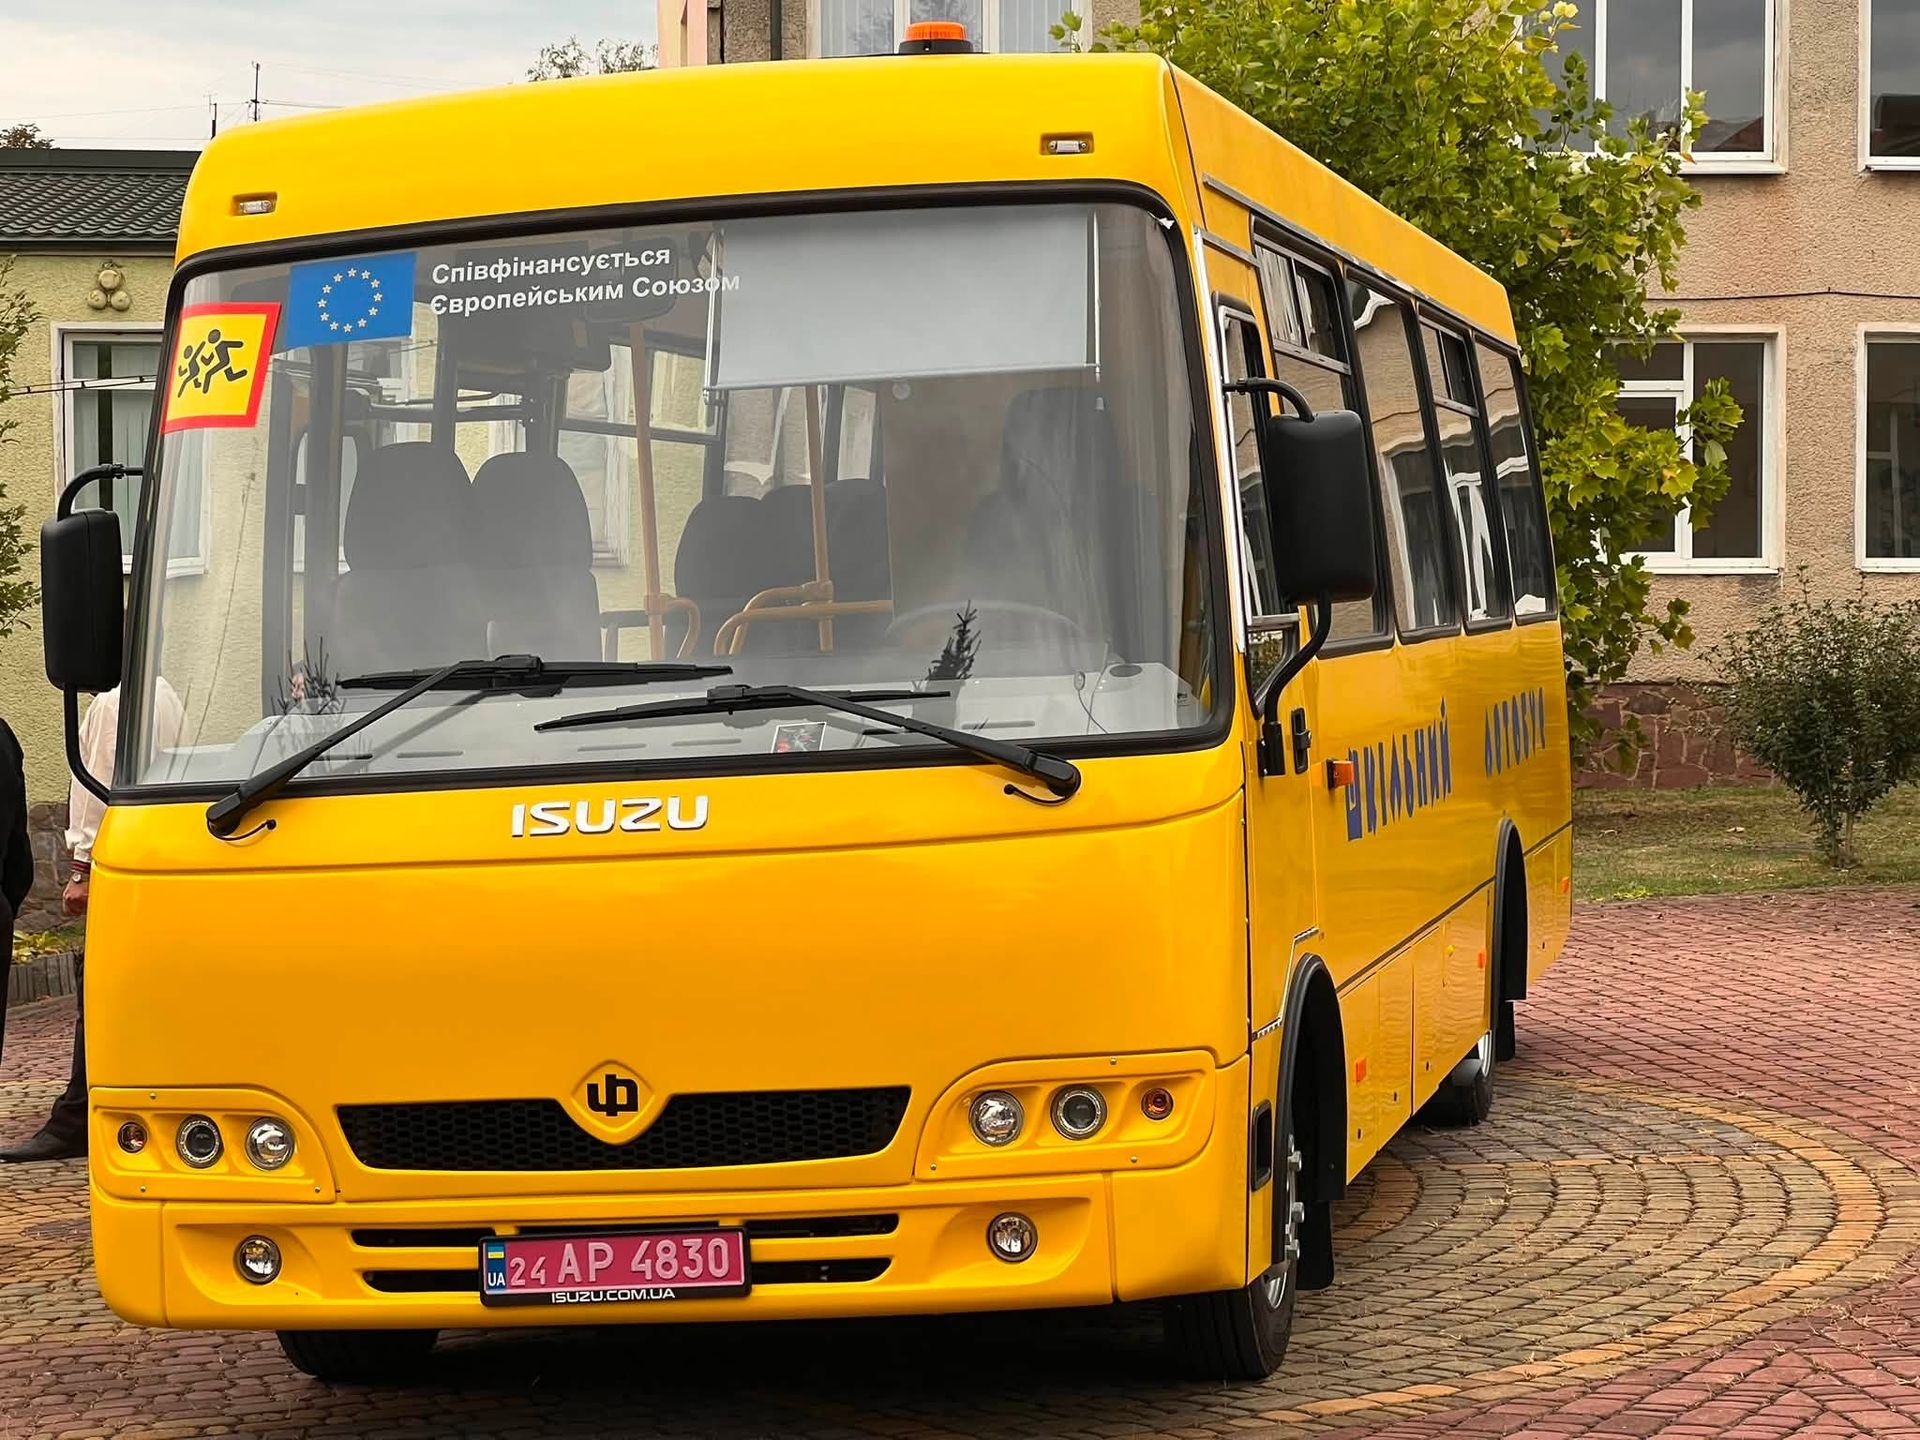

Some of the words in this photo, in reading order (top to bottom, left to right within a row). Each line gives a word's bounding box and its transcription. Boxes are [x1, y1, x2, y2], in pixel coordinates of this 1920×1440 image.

[431, 248, 671, 284] Співфінансується
[430, 281, 624, 316] Європейським
[632, 275, 740, 298] Союзом
[511, 795, 709, 838] ISUZU
[487, 1272, 506, 1287] UA
[510, 1256, 546, 1286] 24
[557, 1242, 614, 1284] AP
[630, 1238, 729, 1281] 4830
[551, 1288, 676, 1304] ISUZU.COM.UA
